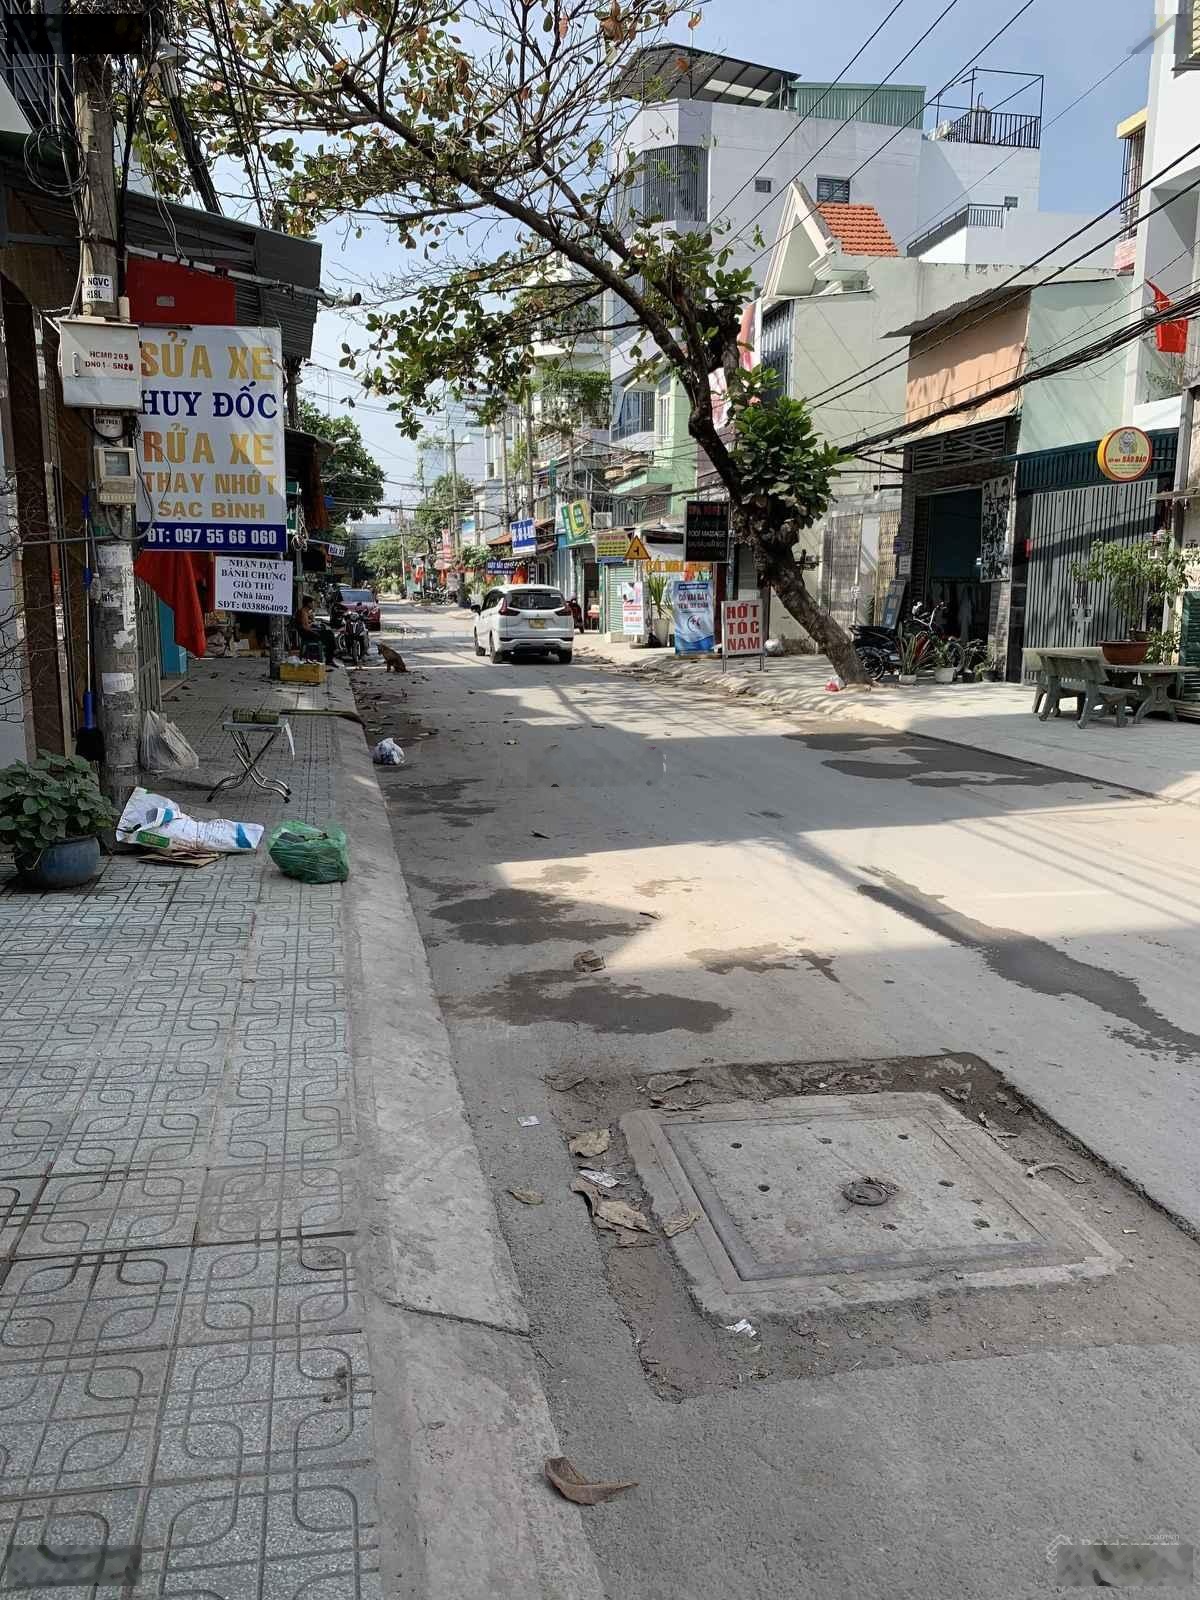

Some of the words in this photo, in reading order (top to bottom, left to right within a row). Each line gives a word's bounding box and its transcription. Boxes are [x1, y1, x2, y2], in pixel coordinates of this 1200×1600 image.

[88, 277, 109, 287] NGVC
[141, 331, 212, 378] SỬA
[227, 345, 273, 379] XE
[140, 390, 202, 416] HUY
[212, 381, 277, 418] ĐỐC
[143, 423, 215, 464] RỬA
[229, 433, 273, 464] XE
[143, 472, 204, 494] THAY
[211, 498, 266, 519] BÌNH
[175, 528, 201, 543] 097
[206, 529, 224, 545] 55
[229, 529, 246, 545] 66
[251, 530, 277, 545] 060
[726, 602, 760, 619] HỚT
[727, 620, 760, 634] TÓC
[727, 637, 761, 651] NAM
